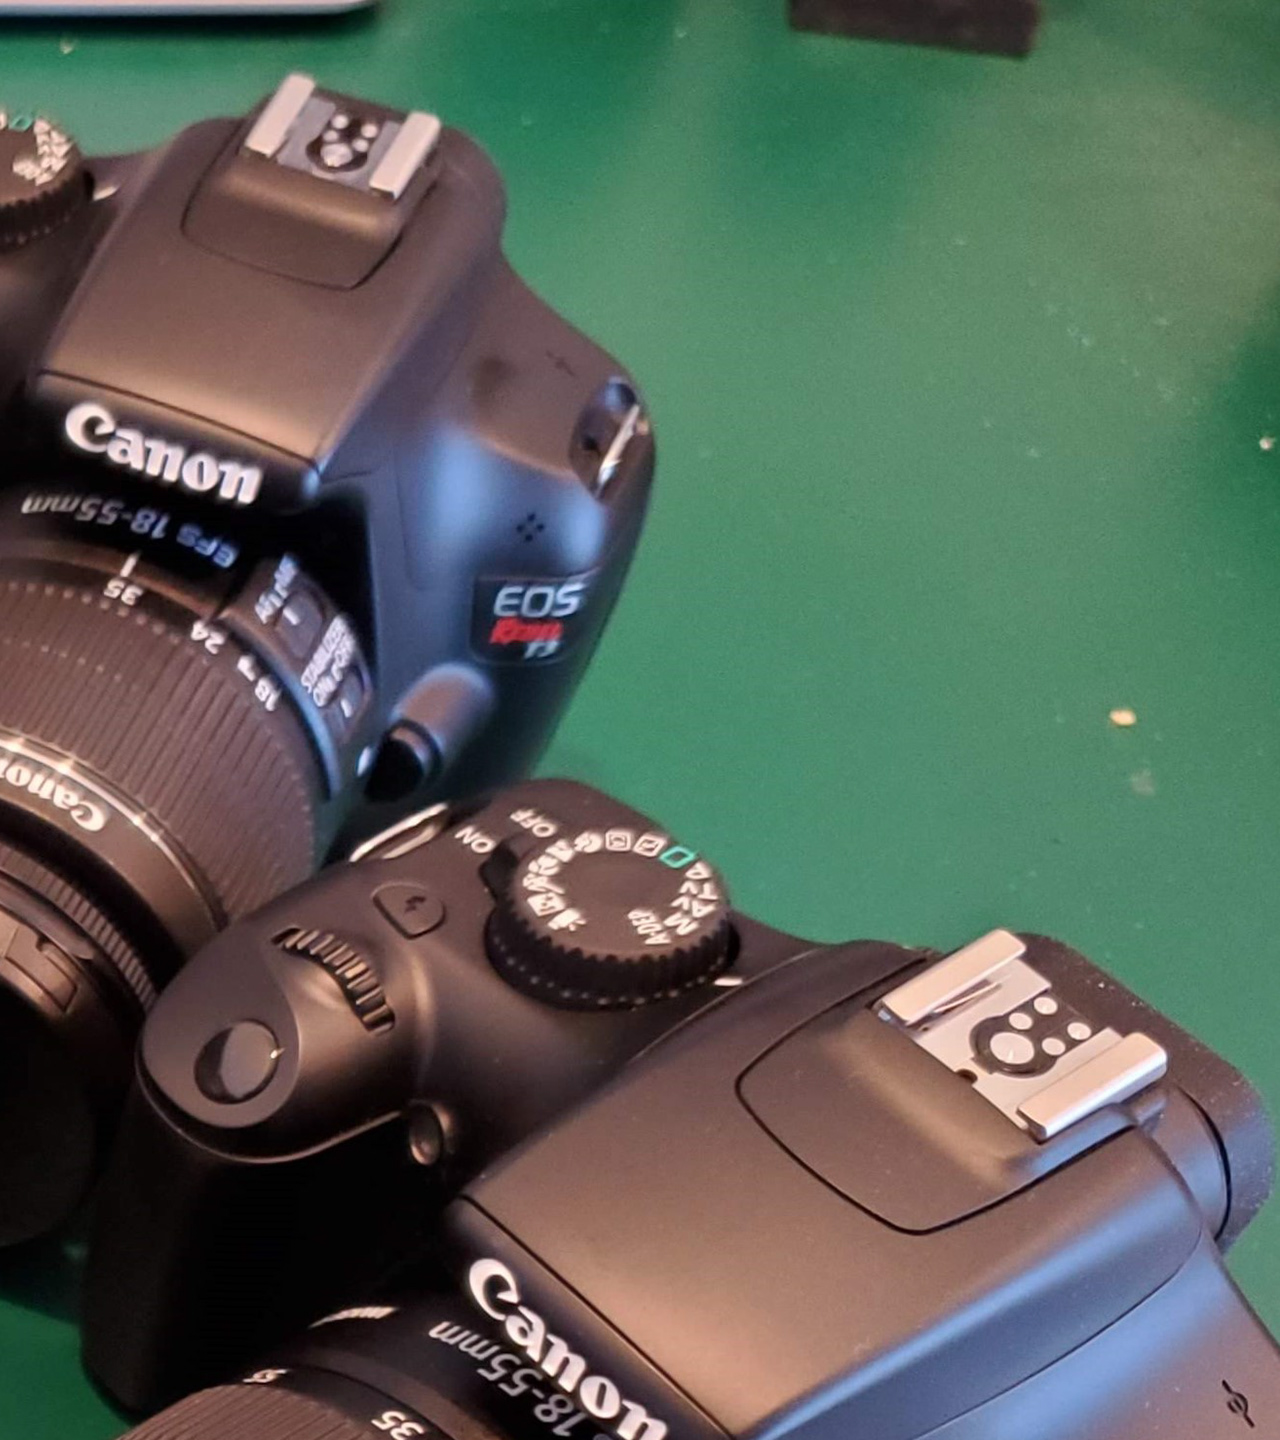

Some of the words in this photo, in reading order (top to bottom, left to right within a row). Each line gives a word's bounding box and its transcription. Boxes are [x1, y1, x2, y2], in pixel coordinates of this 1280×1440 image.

[64, 402, 264, 505] Canon
[20, 494, 170, 540] 18-55mm
[176, 523, 238, 569] EFS
[103, 577, 144, 605] 35
[493, 583, 587, 618] EOS
[191, 621, 226, 655] 24
[254, 676, 281, 711] 18
[454, 825, 495, 854] ON
[510, 808, 557, 838] OFF
[685, 860, 712, 880] P
[663, 912, 700, 936] M
[428, 1321, 589, 1437] 18-55mm
